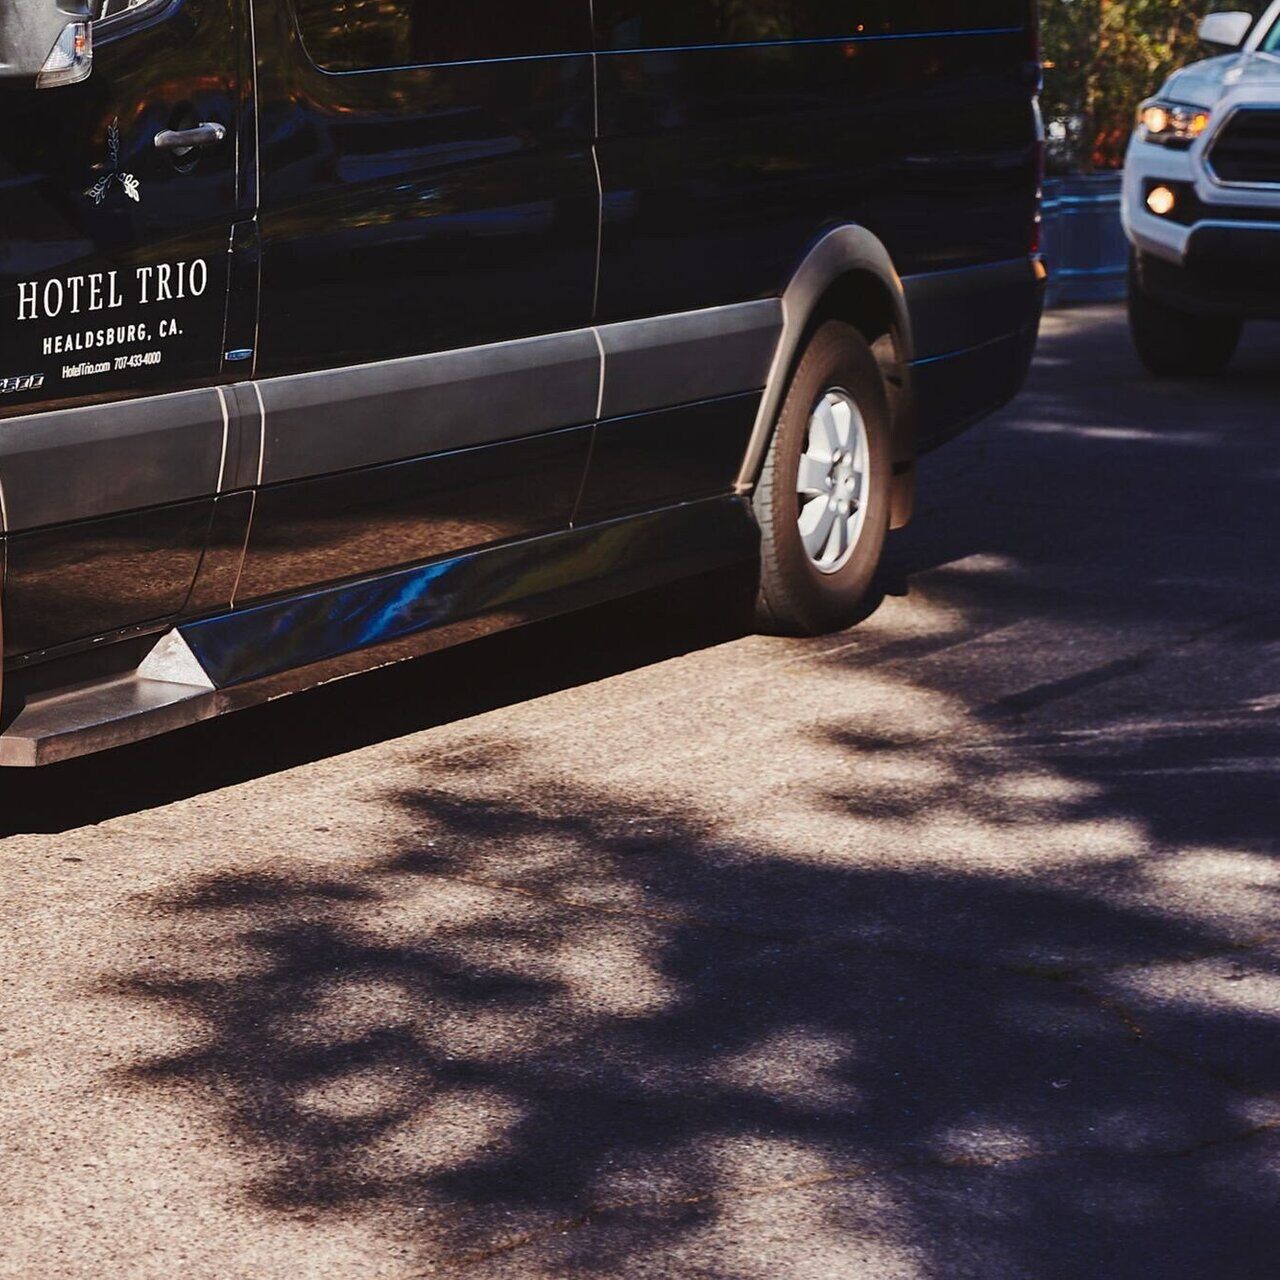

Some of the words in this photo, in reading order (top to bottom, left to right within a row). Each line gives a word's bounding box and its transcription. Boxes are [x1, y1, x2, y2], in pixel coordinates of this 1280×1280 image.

[16, 270, 123, 321] HOTEL
[136, 258, 208, 305] TRIO
[42, 322, 152, 355] HEALDSBURG,
[158, 318, 184, 338] CA.
[61, 360, 111, 379] HotelTrio.com
[113, 350, 162, 371] 707-433-4000
